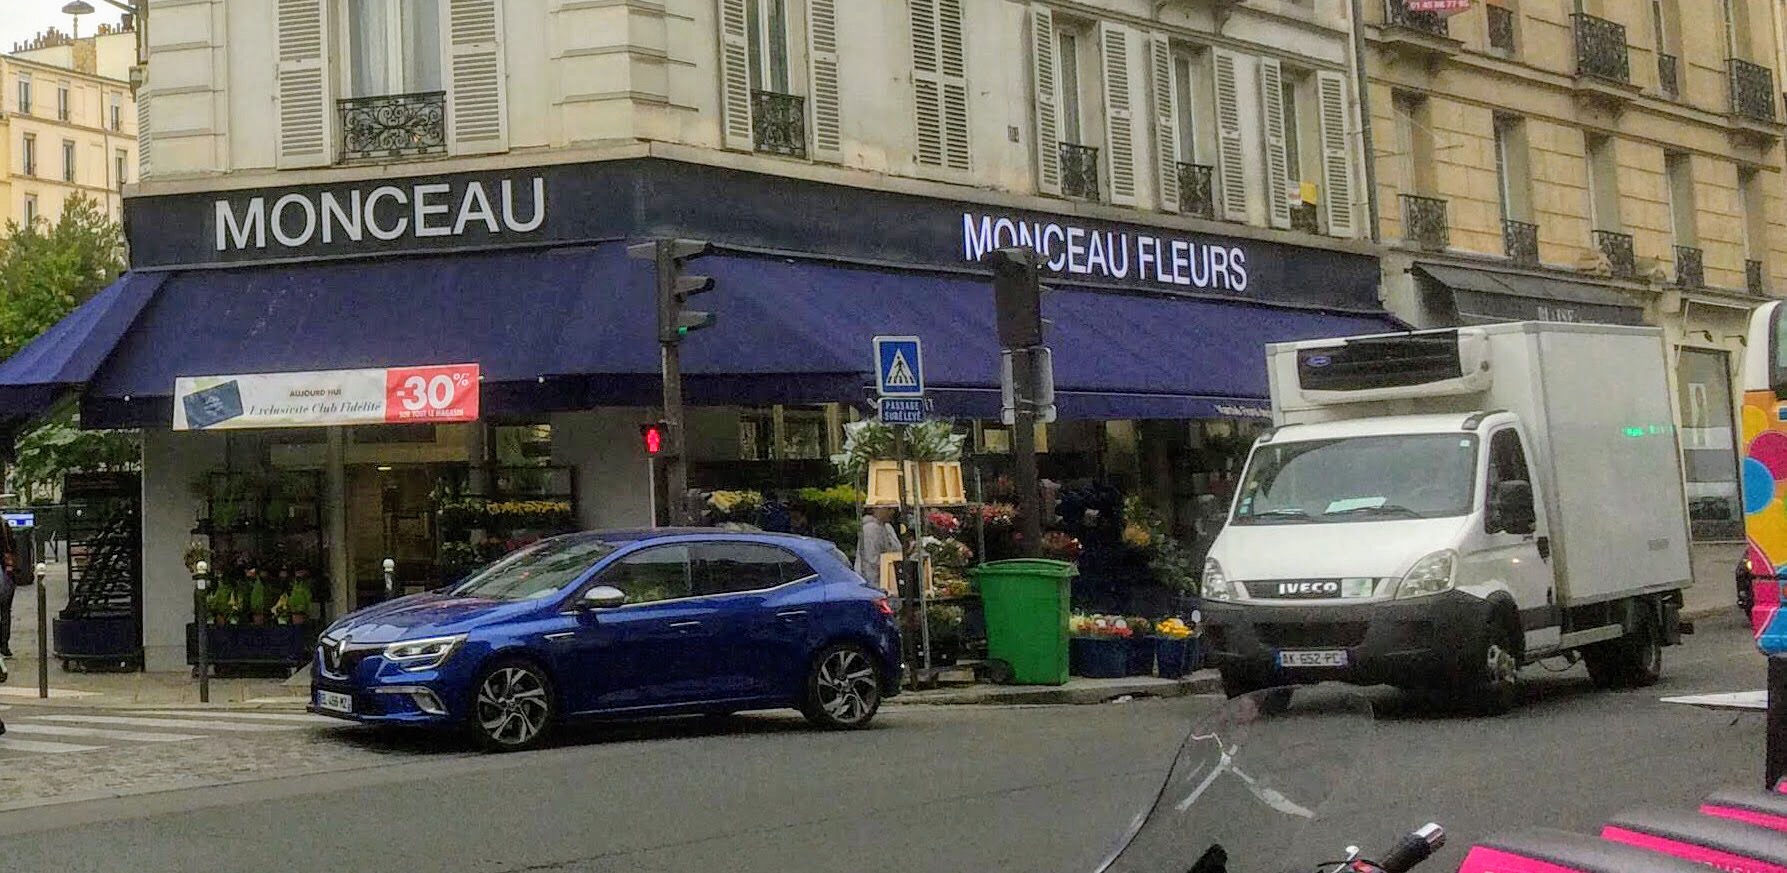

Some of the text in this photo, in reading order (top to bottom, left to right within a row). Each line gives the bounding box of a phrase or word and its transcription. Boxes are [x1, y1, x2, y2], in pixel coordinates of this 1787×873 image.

[214, 177, 544, 251] MONCEAU
[1137, 236, 1248, 292] FLEURS
[312, 403, 337, 414] Club
[885, 401, 919, 410] PASSAGE
[436, 409, 464, 417] MAGASIN
[1279, 582, 1338, 595] IVECO
